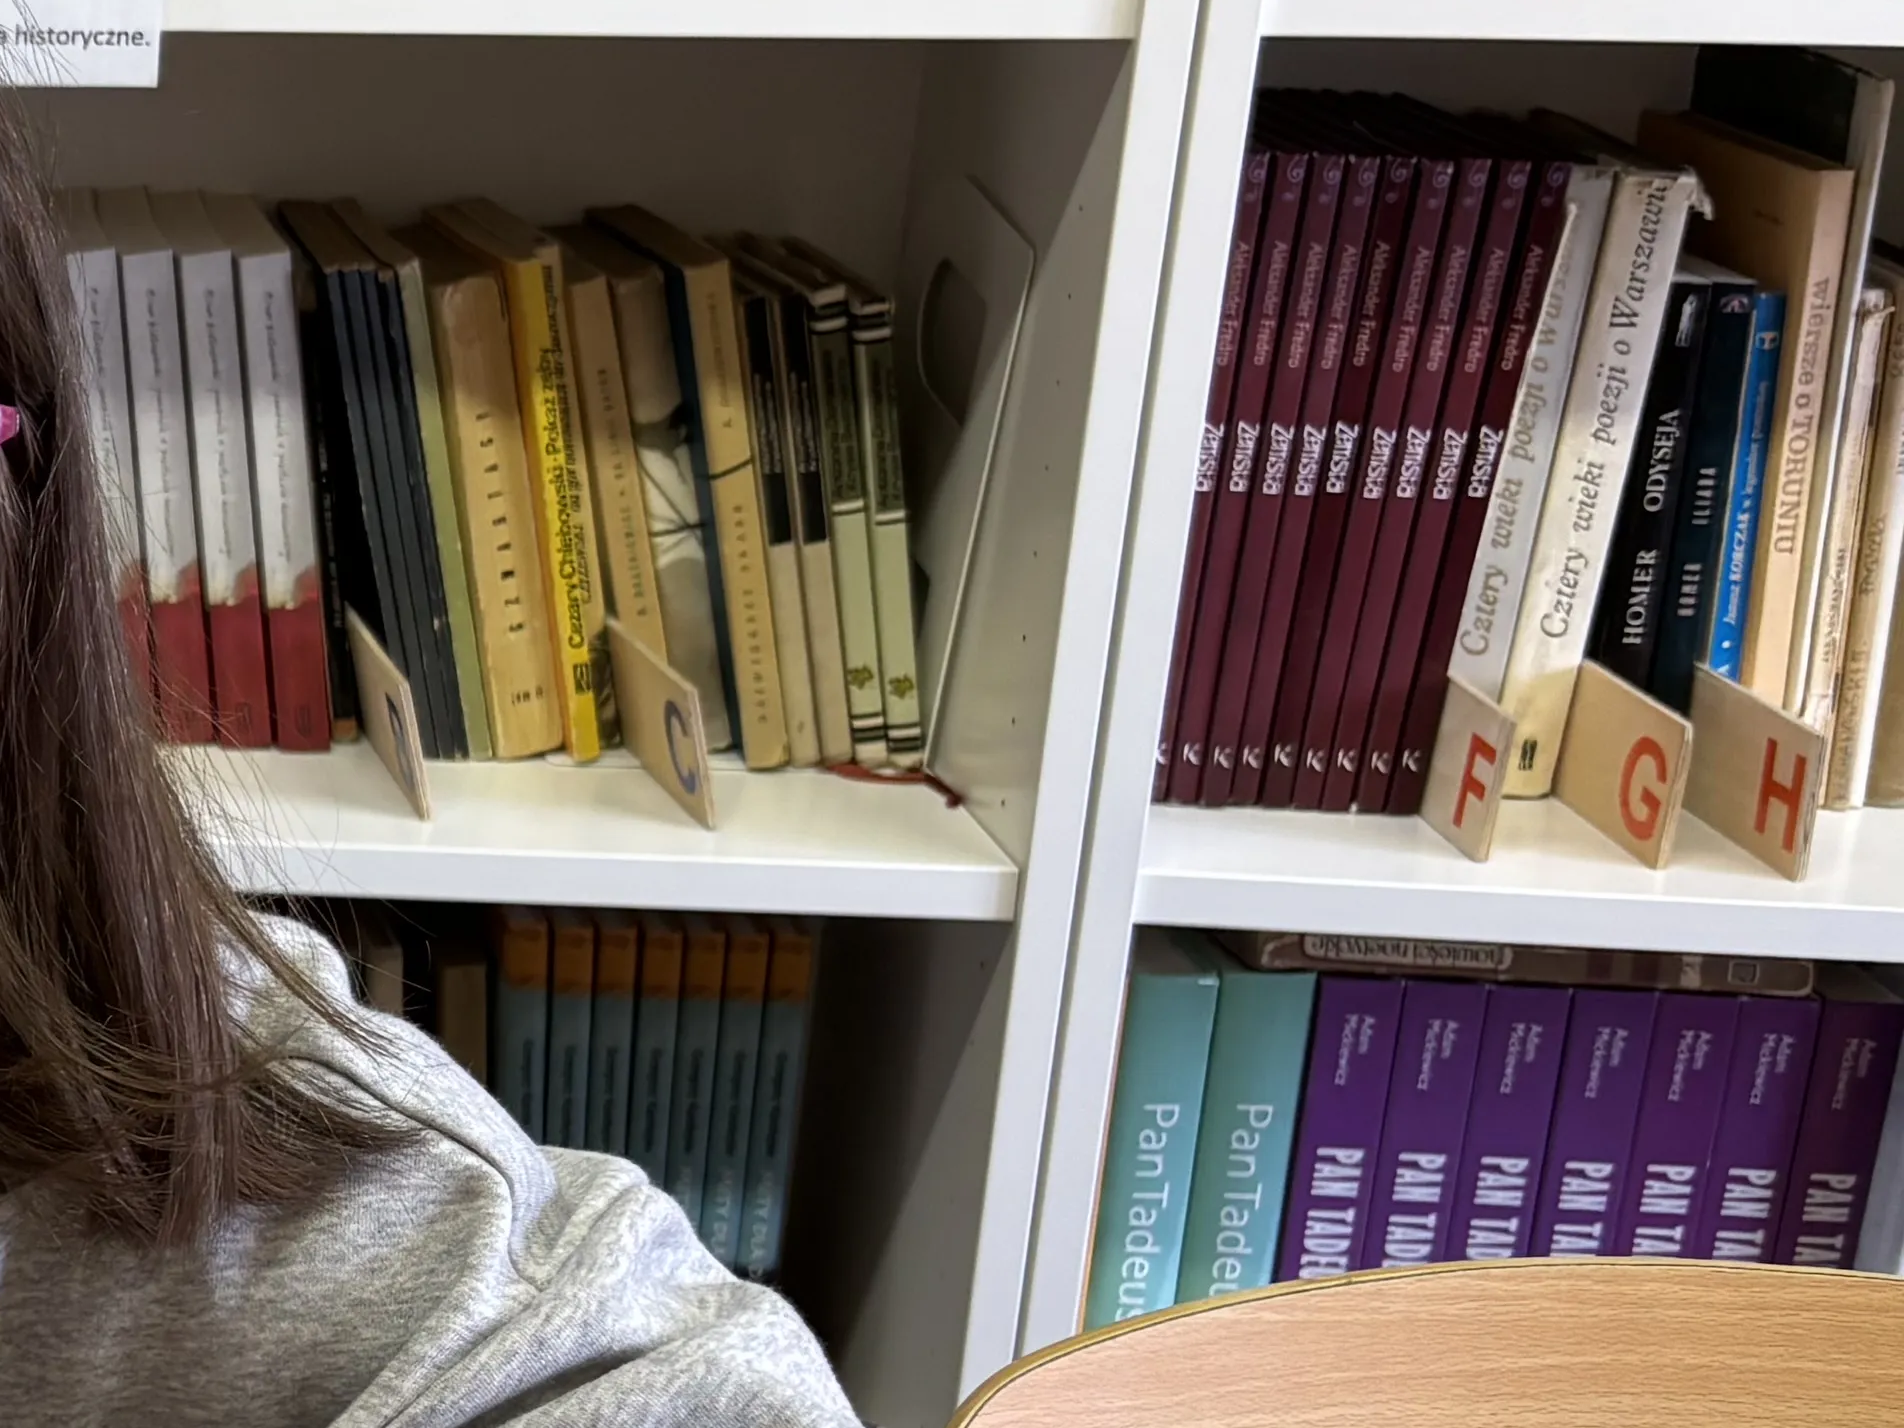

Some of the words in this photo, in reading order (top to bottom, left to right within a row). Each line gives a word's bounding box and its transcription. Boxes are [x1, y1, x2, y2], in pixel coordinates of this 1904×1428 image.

[15, 24, 152, 50] historyczne.
[1540, 551, 1592, 640] Cztery
[1568, 454, 1607, 540] wieki
[1592, 365, 1627, 449] poezji
[1621, 549, 1658, 647] HOMER
[1642, 408, 1682, 514] ODYSEJA
[1772, 414, 1809, 555] TORUNIU
[664, 699, 697, 794] C
[1452, 733, 1497, 828] F
[1619, 735, 1667, 841] G
[1753, 737, 1806, 853] H
[1136, 1103, 1180, 1178] Pan
[1310, 1147, 1366, 1197] PAN
[1645, 1163, 1696, 1214] PAN
[1809, 1171, 1857, 1222] PAN
